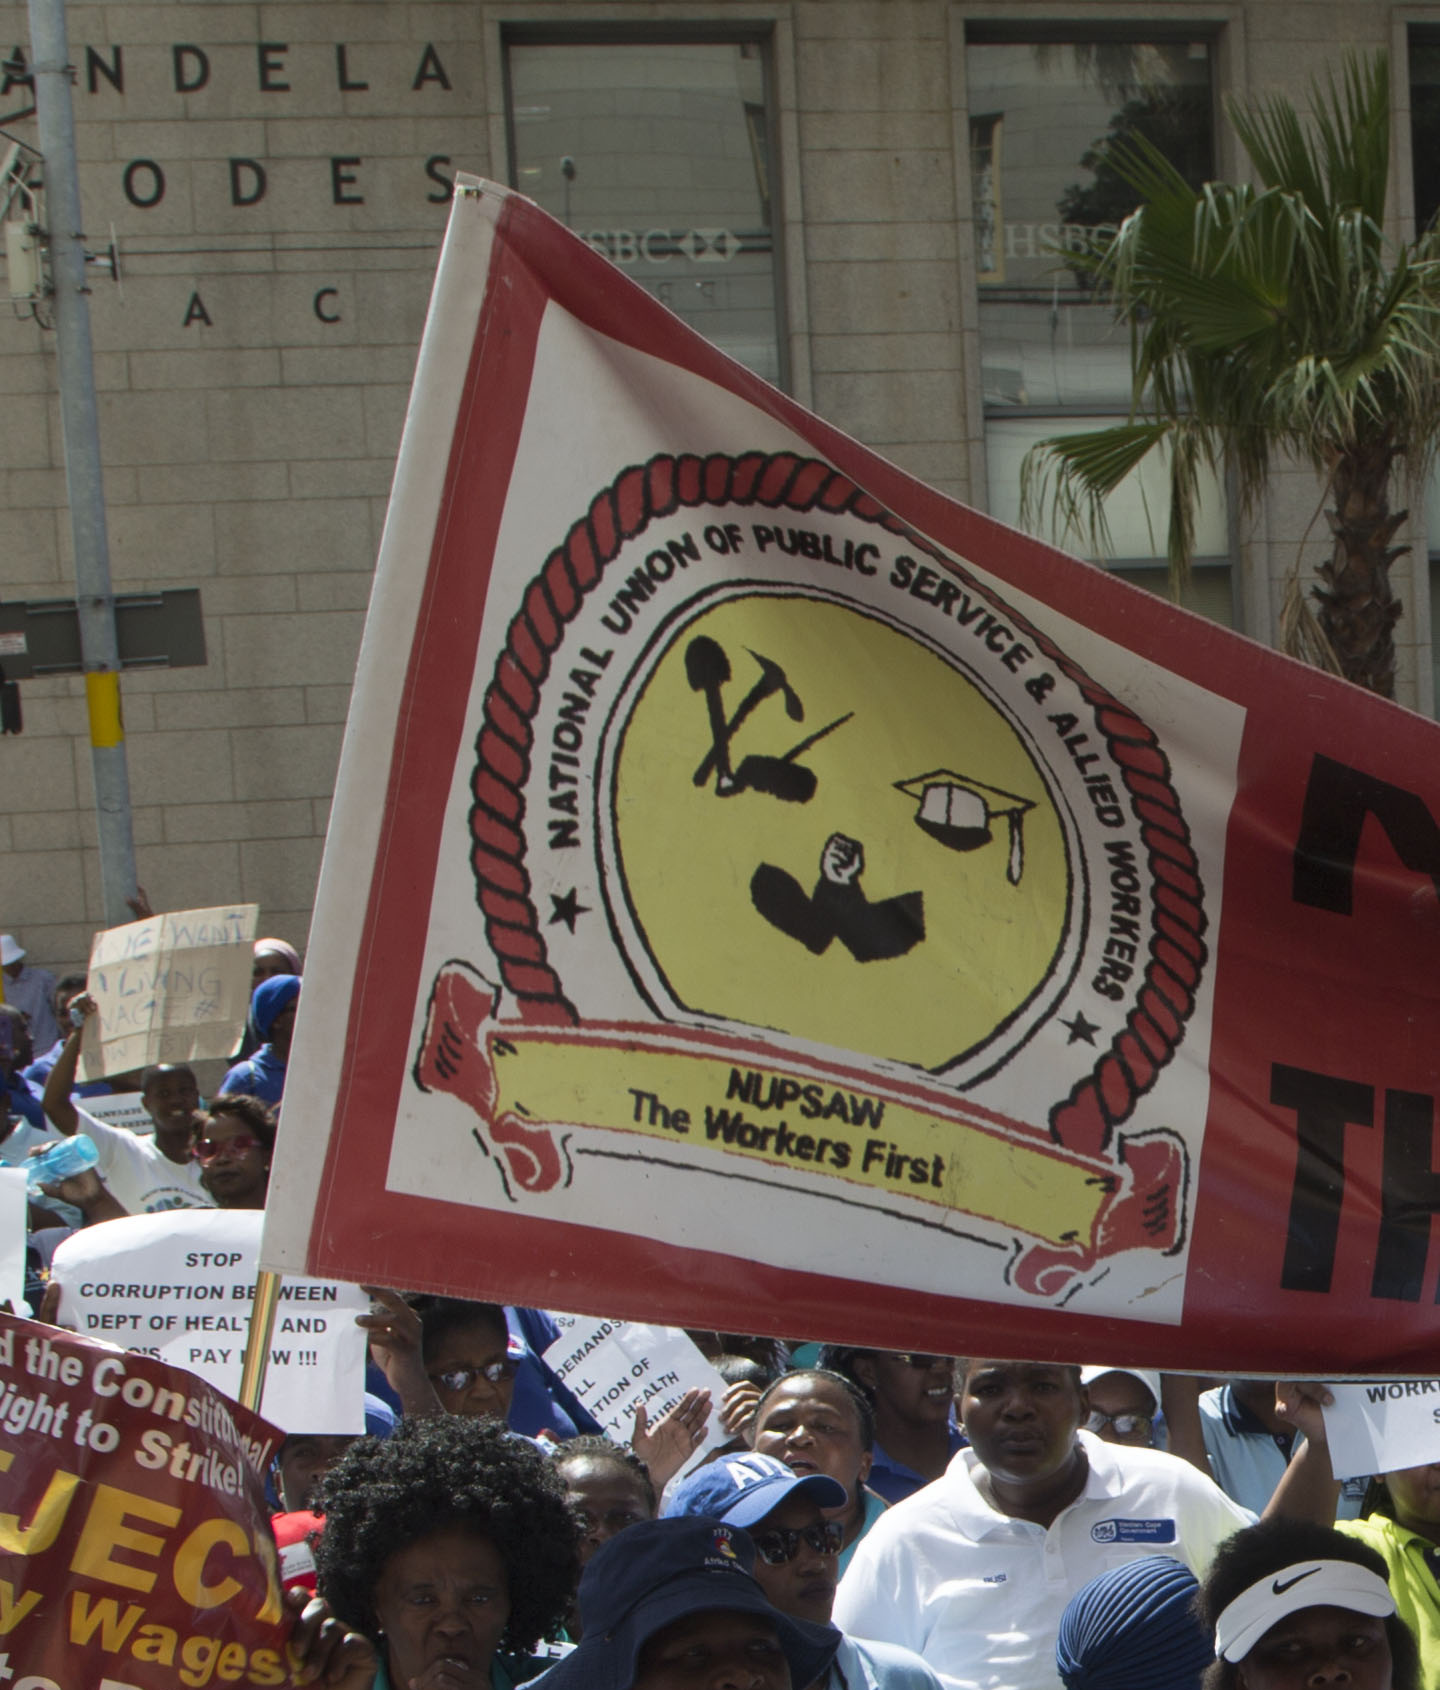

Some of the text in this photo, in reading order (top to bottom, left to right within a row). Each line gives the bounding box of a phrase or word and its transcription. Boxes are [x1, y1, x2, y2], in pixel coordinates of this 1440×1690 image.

[548, 523, 1142, 1002] NATIONAL UNION OF PUBLIC SERVICE & ALLIED WORKERS
[726, 1067, 887, 1130] NUPSAW
[628, 1087, 948, 1189] The Workers First
[185, 1252, 243, 1269] STOP
[80, 1282, 338, 1302] CORRUPTION BEWEEN
[87, 1313, 328, 1334] DEPT OF AND
[24, 1332, 83, 1387] the
[189, 1347, 233, 1364] PAY
[631, 1356, 652, 1378] OF
[622, 1370, 680, 1420] HEALTH
[73, 1407, 120, 1454] to
[132, 1428, 247, 1499] Strike!
